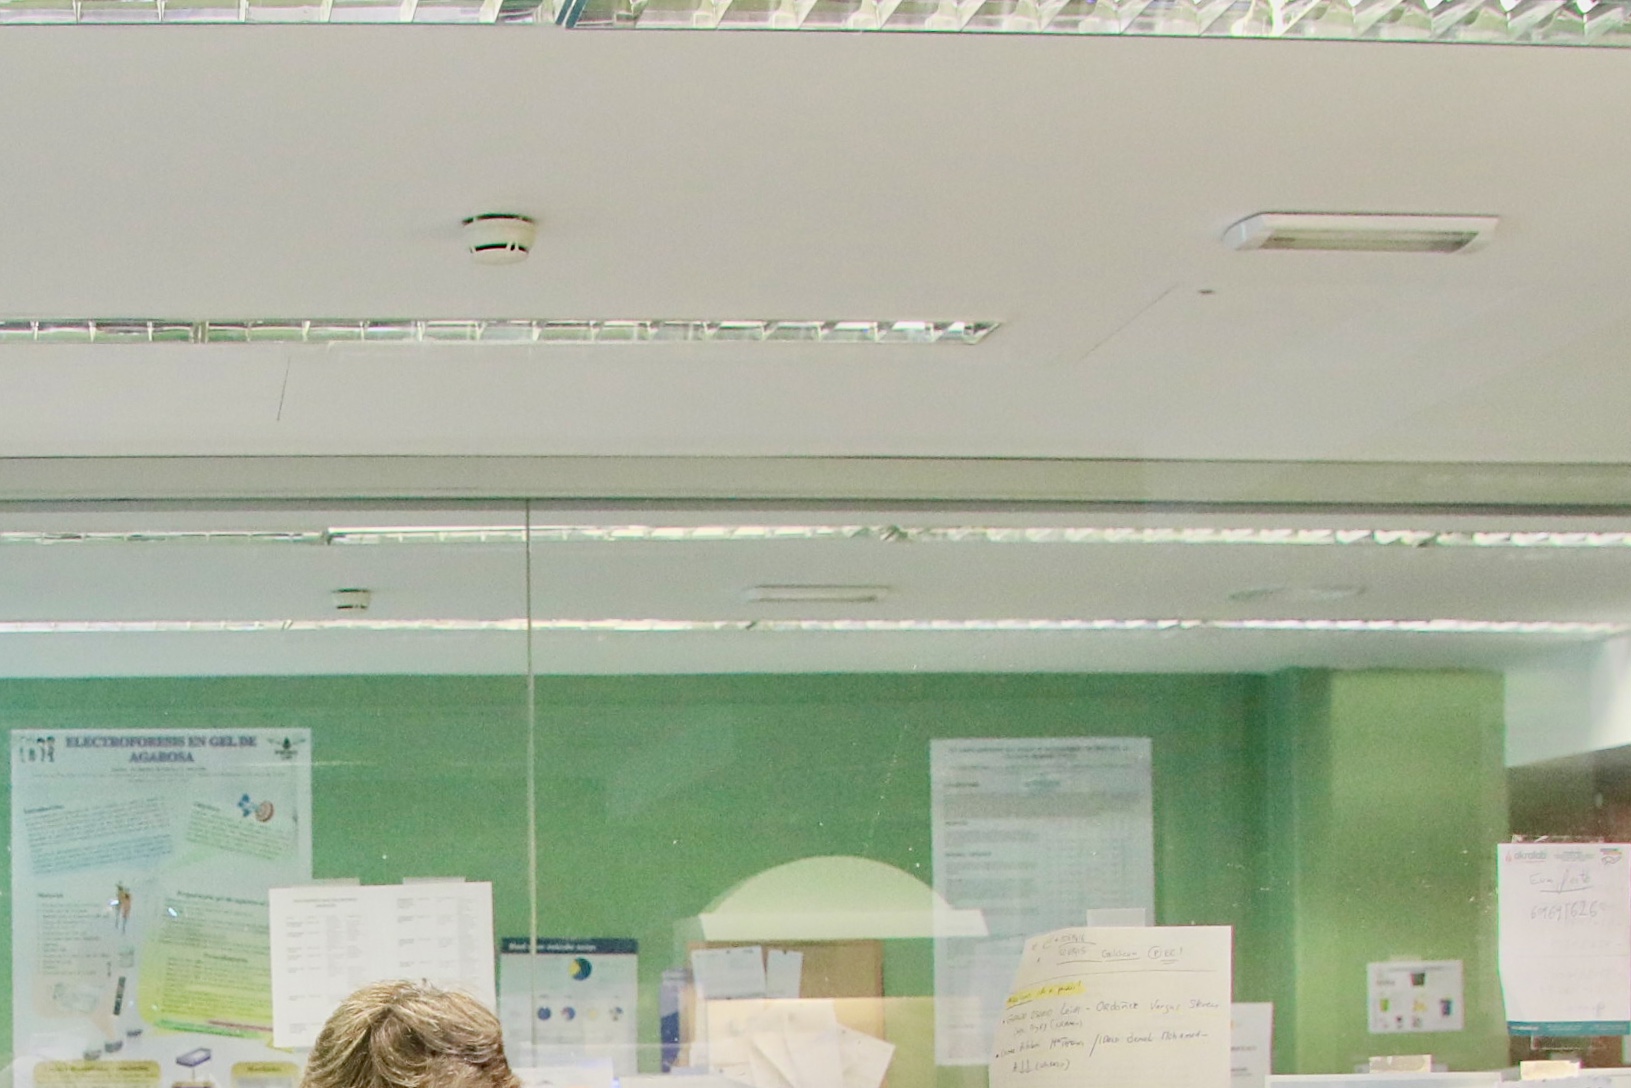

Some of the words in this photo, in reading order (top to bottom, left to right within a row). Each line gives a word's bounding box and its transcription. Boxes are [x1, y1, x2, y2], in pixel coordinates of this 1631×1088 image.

[67, 736, 185, 747] ELECTROFORESIS
[189, 737, 206, 747] EN
[210, 737, 237, 746] GEL
[240, 737, 256, 746] DE
[129, 752, 194, 762] AGAROSA
